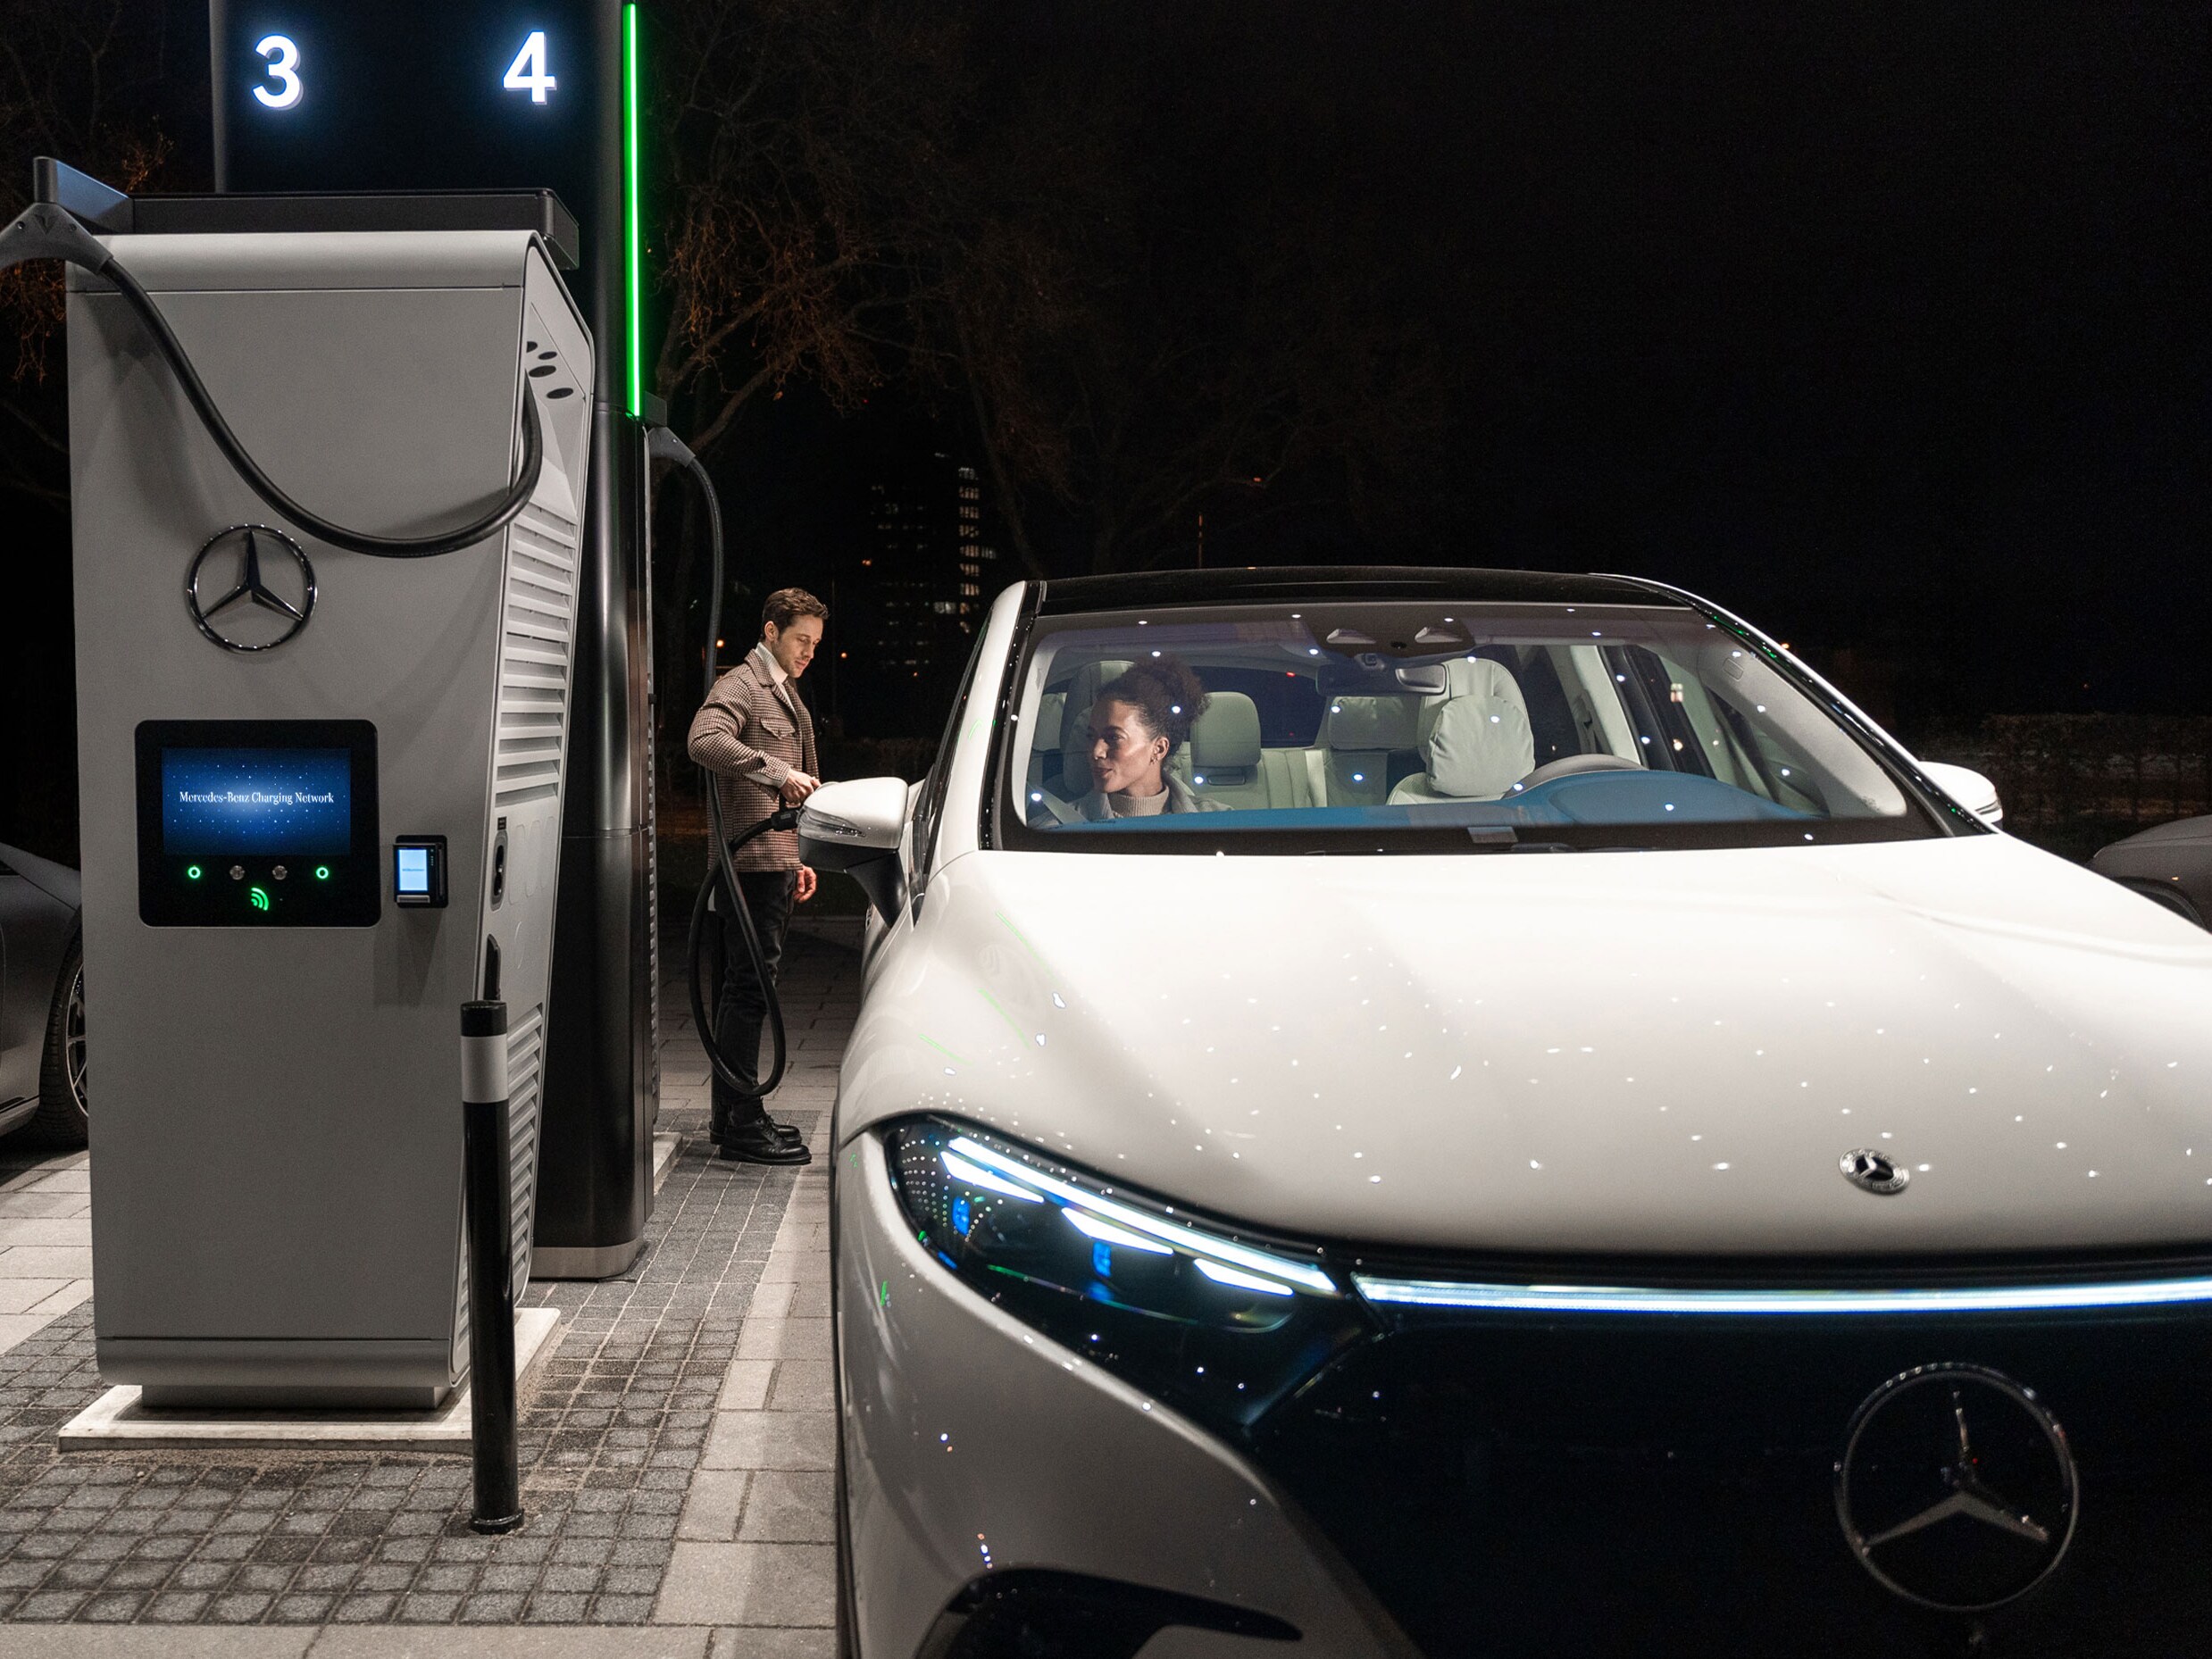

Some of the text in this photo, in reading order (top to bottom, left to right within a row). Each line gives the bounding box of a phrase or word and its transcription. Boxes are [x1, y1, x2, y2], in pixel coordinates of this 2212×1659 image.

[253, 34, 304, 109] 3
[503, 30, 556, 105] 4
[179, 791, 334, 805] Mercedes-Benz Charging Network
